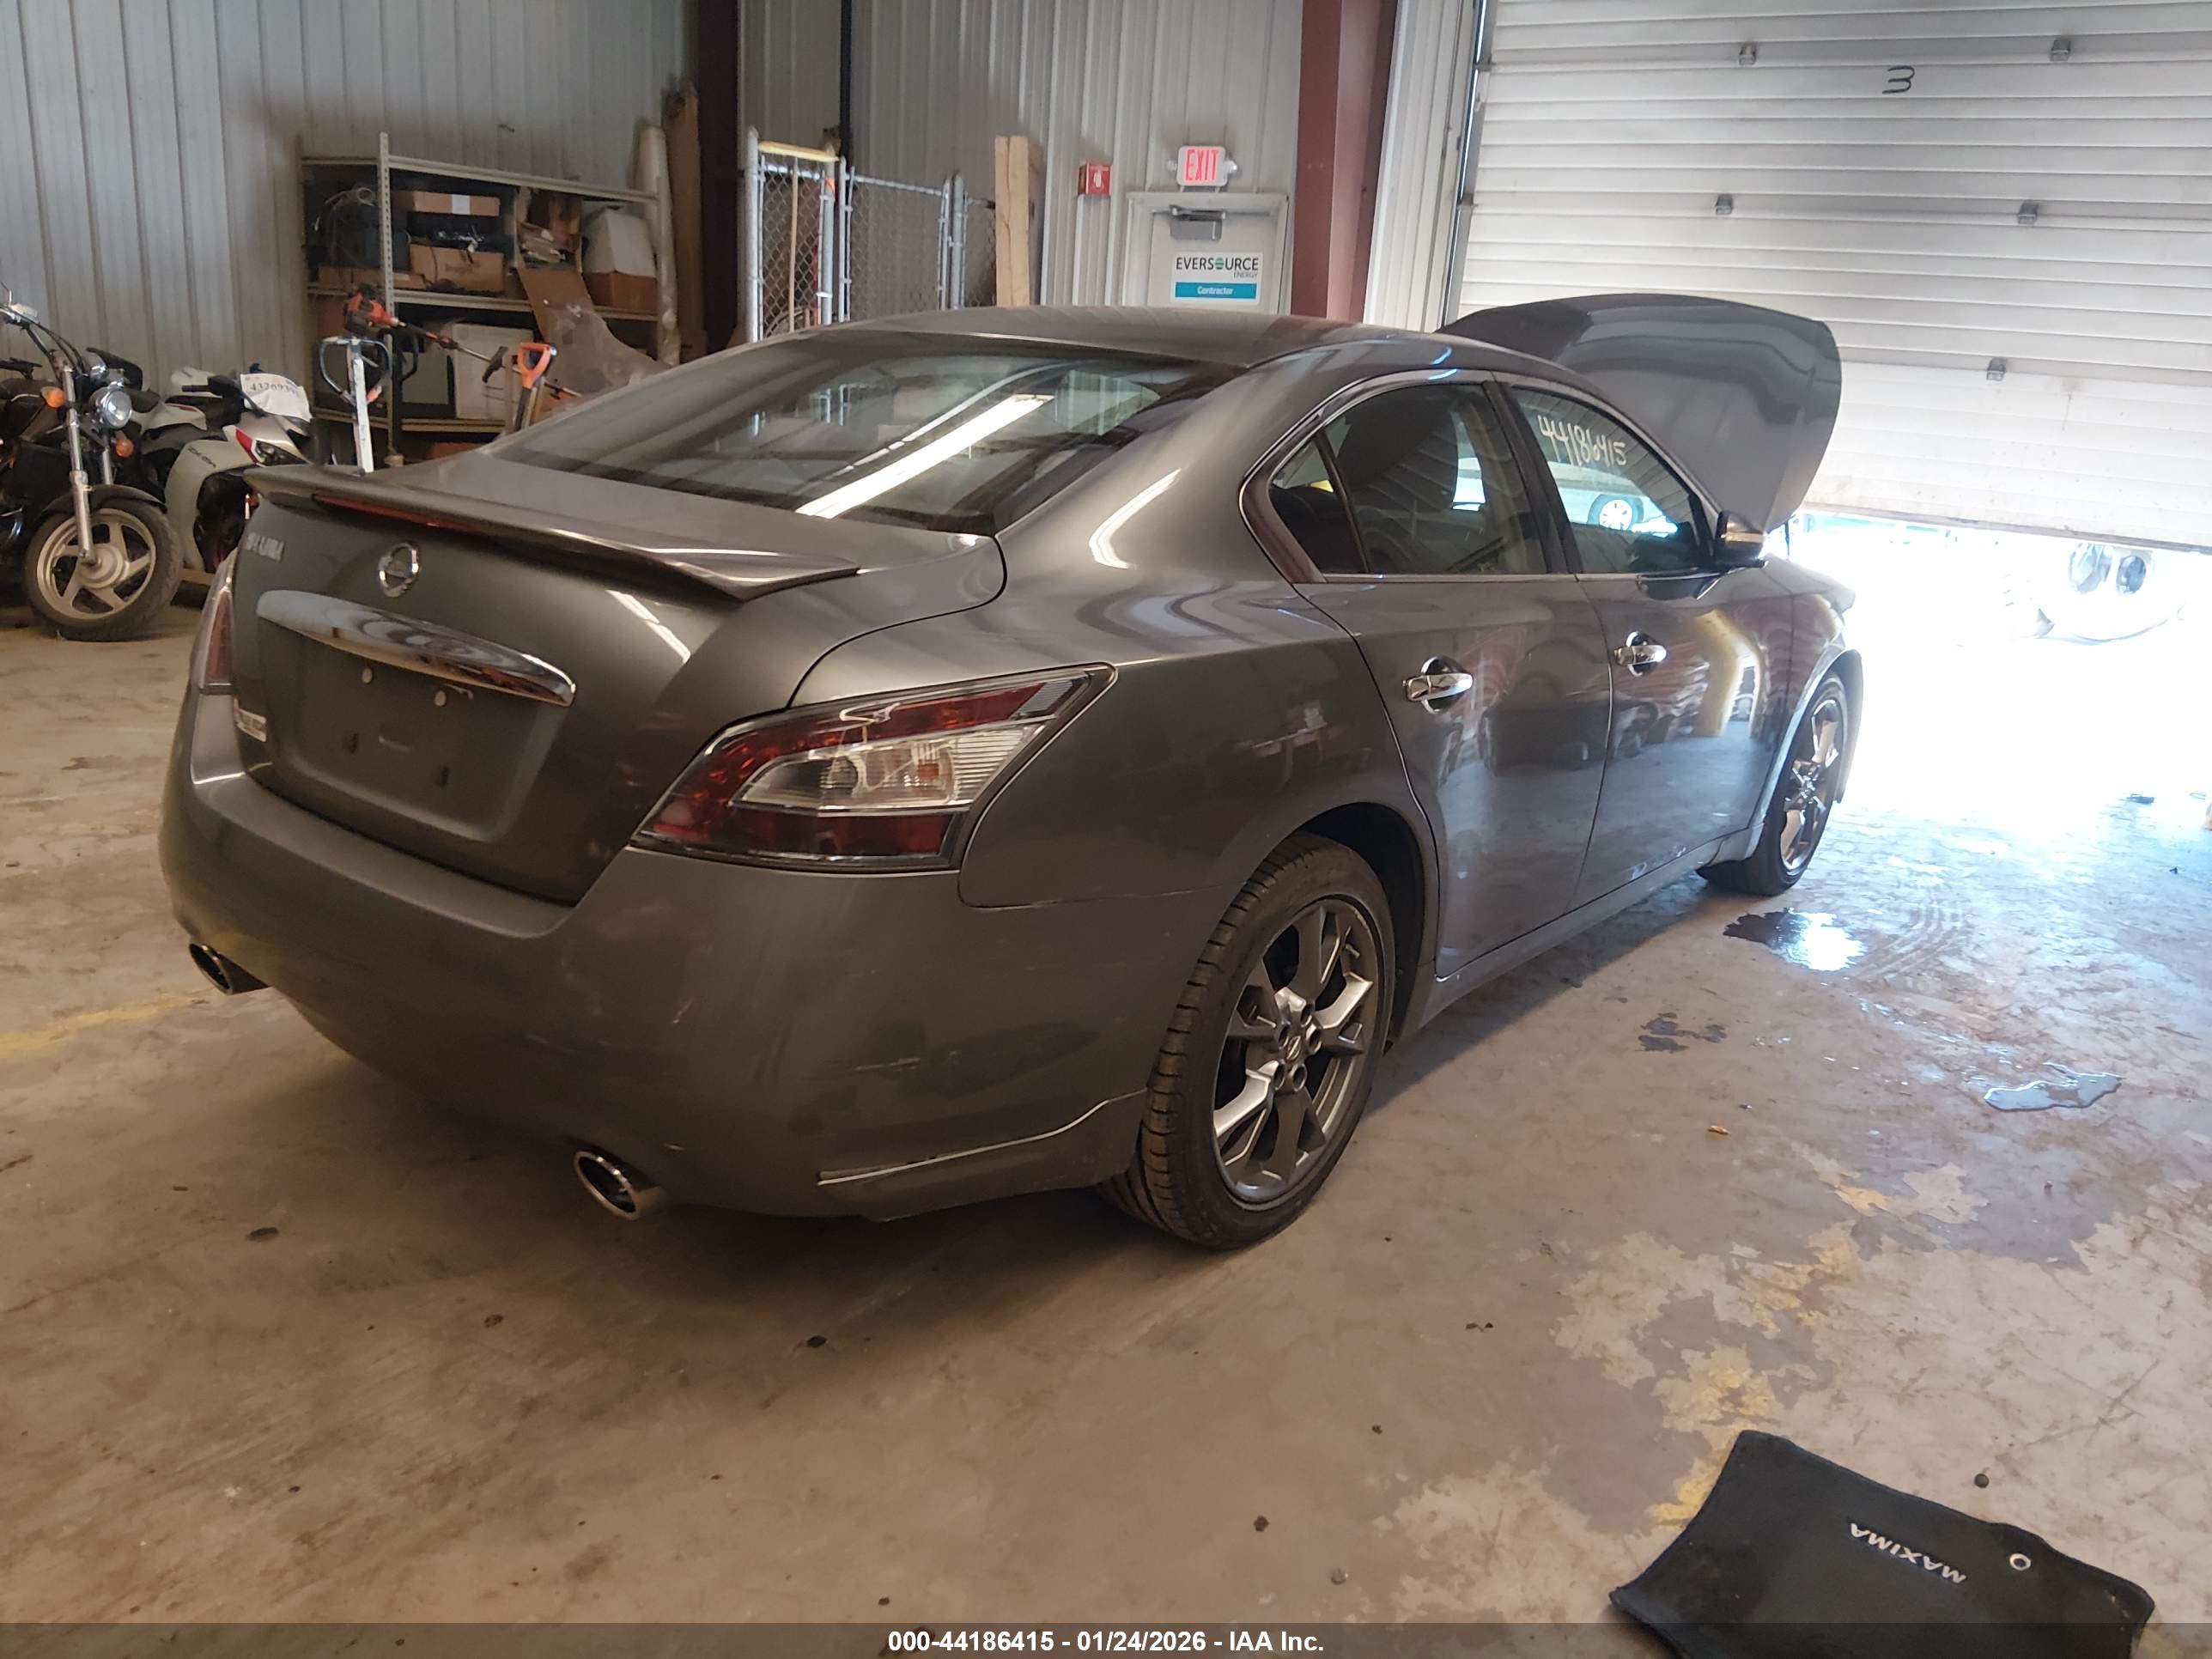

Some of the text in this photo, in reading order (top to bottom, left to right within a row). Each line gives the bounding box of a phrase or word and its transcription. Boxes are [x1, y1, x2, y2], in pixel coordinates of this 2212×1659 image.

[1882, 65, 1915, 94] 3
[1185, 149, 1219, 181] EXIT
[1176, 257, 1259, 270] EVERSOURCE
[1196, 286, 1234, 295] Contractor
[1537, 415, 1626, 467] 44186415
[1850, 1522, 1966, 1583] MAXIMA
